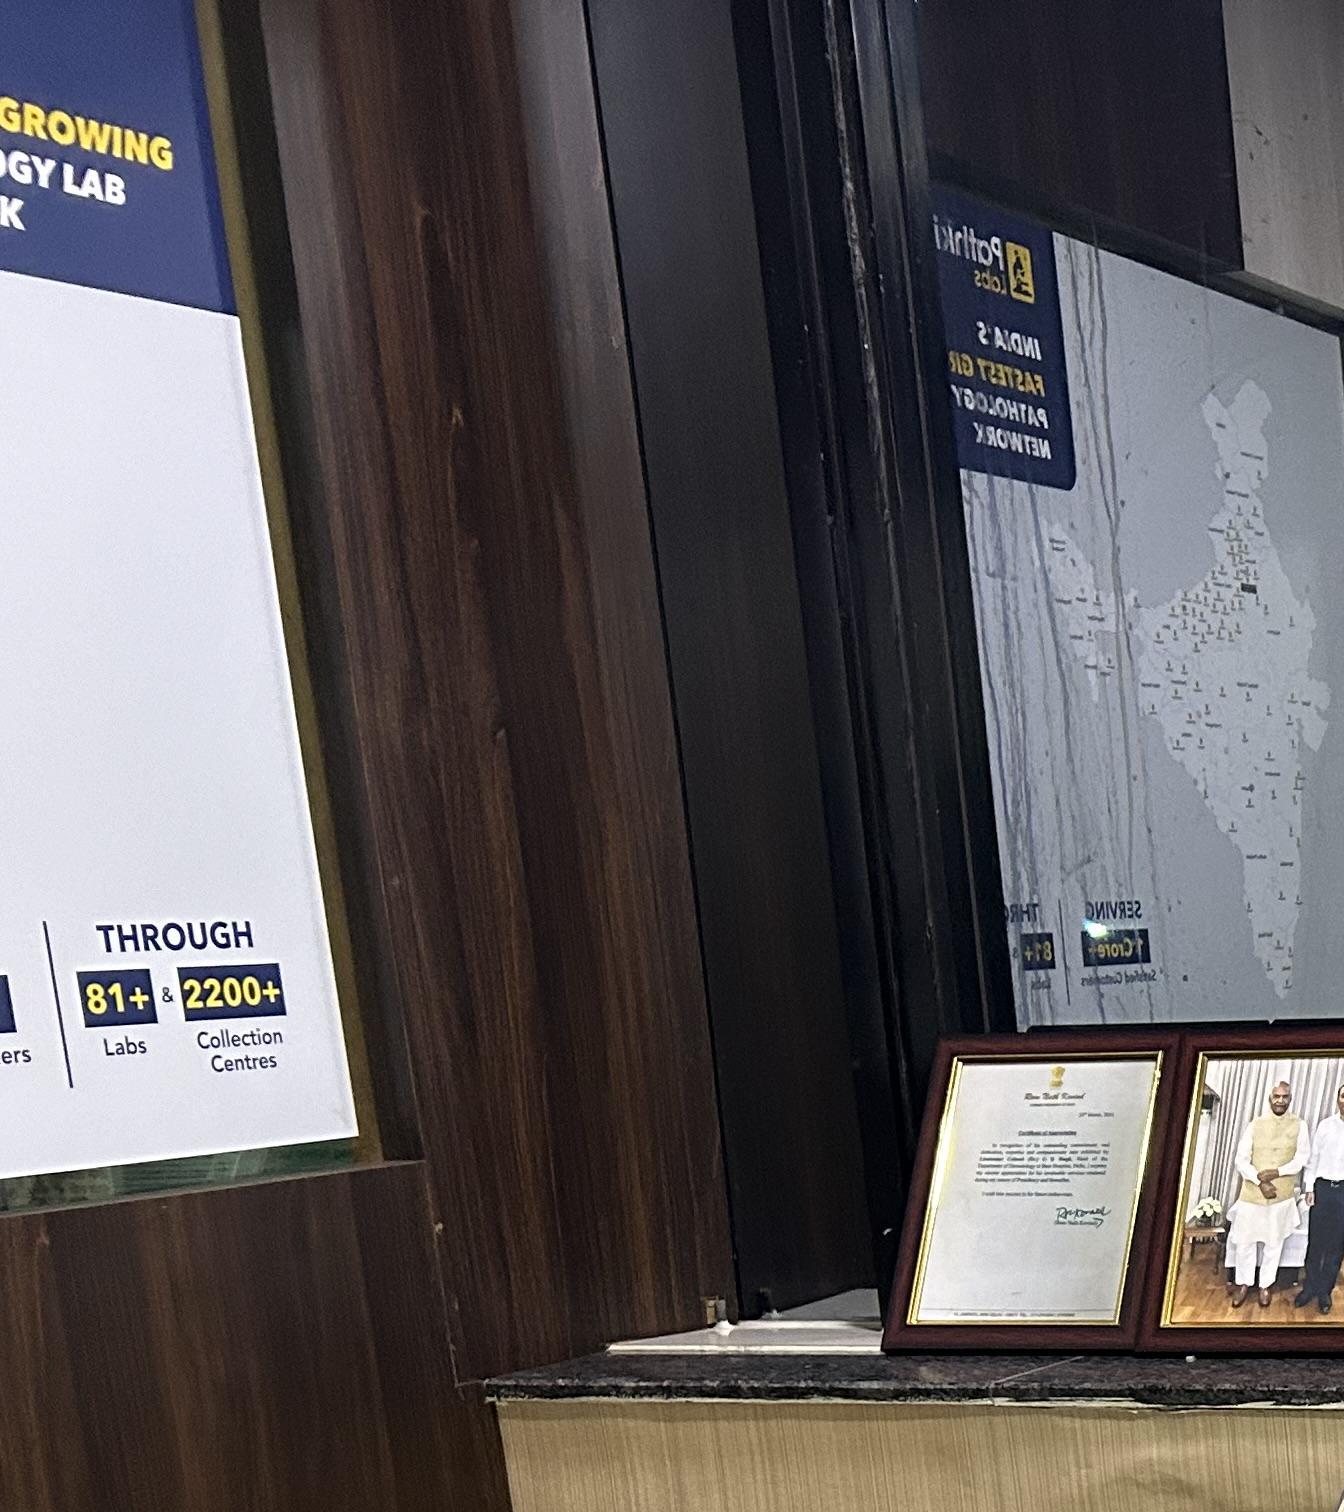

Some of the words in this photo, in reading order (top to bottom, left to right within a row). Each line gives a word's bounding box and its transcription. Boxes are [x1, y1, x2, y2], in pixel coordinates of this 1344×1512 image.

[0, 96, 173, 171] GROWING
[62, 162, 126, 205] LAB
[96, 921, 254, 953] THROUGH
[85, 982, 149, 1015] 81+
[162, 988, 174, 1003] &
[184, 976, 280, 1009] 2200+
[103, 1037, 147, 1056] Labs
[197, 1029, 283, 1050] Collection
[211, 1053, 277, 1073] Centres
